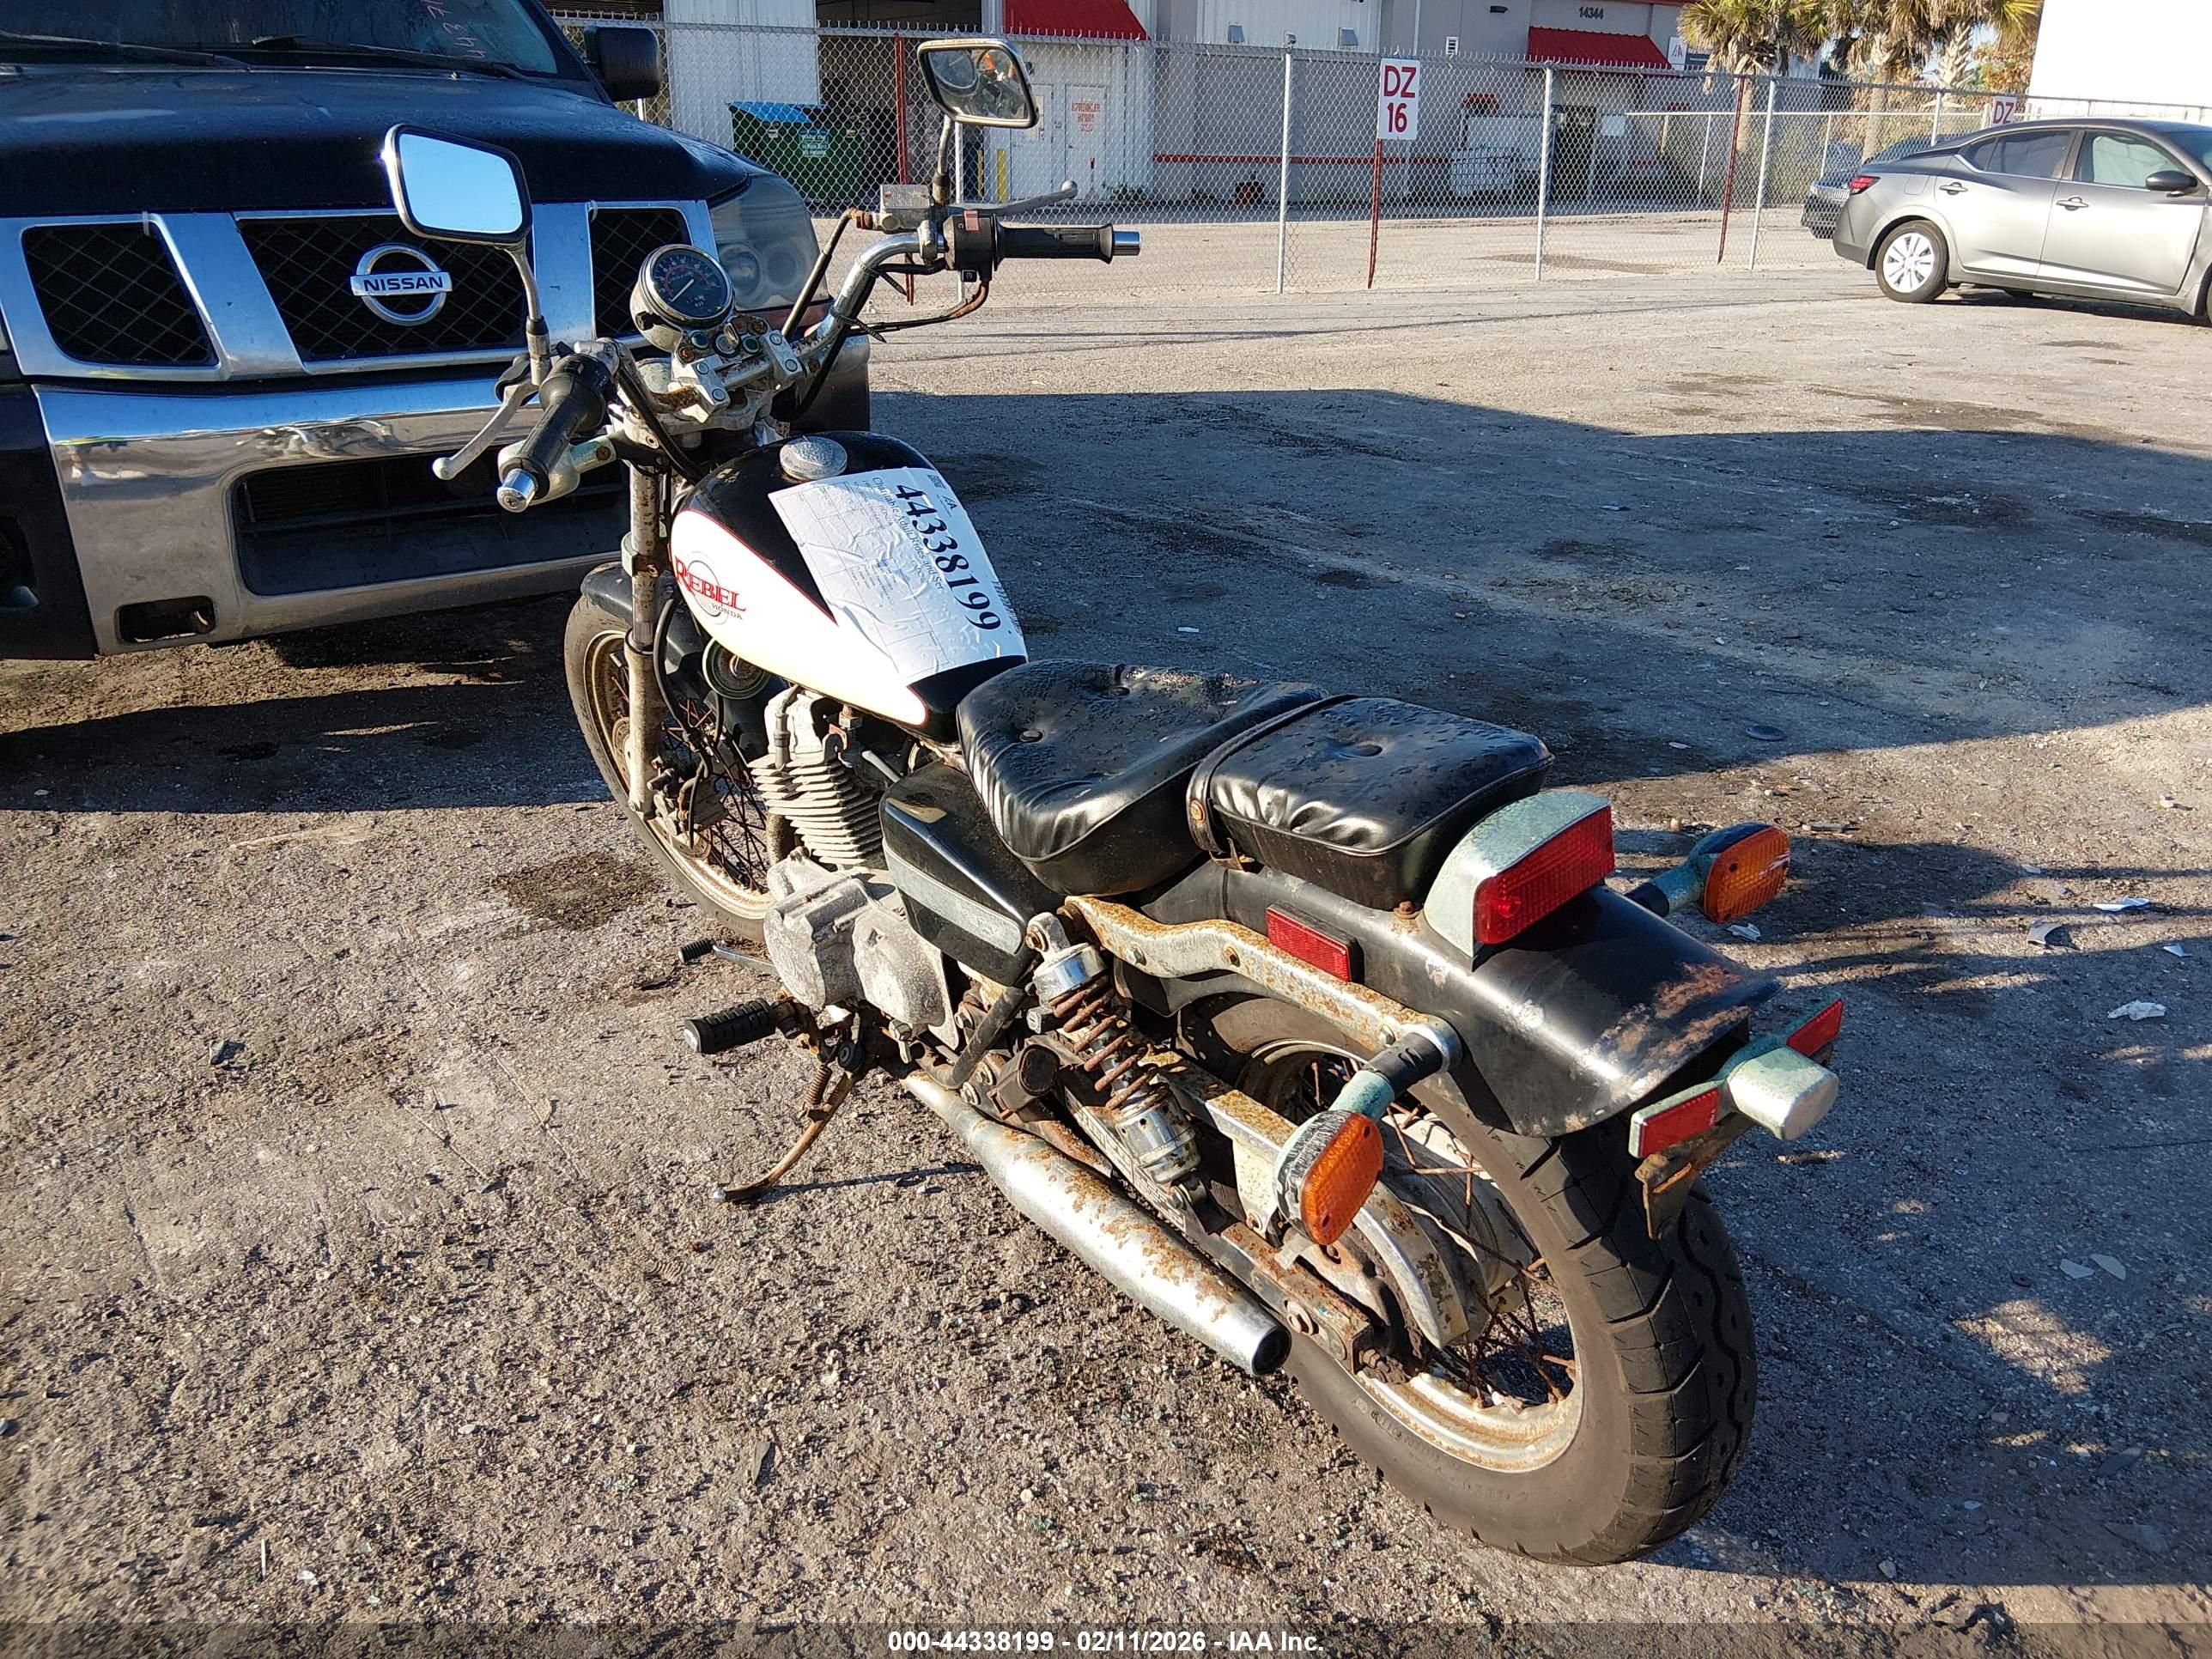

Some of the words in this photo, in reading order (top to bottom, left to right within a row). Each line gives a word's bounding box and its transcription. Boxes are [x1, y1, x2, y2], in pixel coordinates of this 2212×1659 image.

[1578, 6, 1604, 20] 14344
[1383, 64, 1417, 98] DZ
[1387, 102, 1407, 132] 16
[1992, 100, 2014, 124] DZ
[363, 276, 443, 292] NISSAN
[896, 514, 915, 536] Adult
[910, 535, 927, 559] Rides
[922, 560, 939, 575] and
[896, 484, 1001, 630] 44338199
[674, 555, 747, 612] REBEL
[711, 602, 743, 620] HONDA
